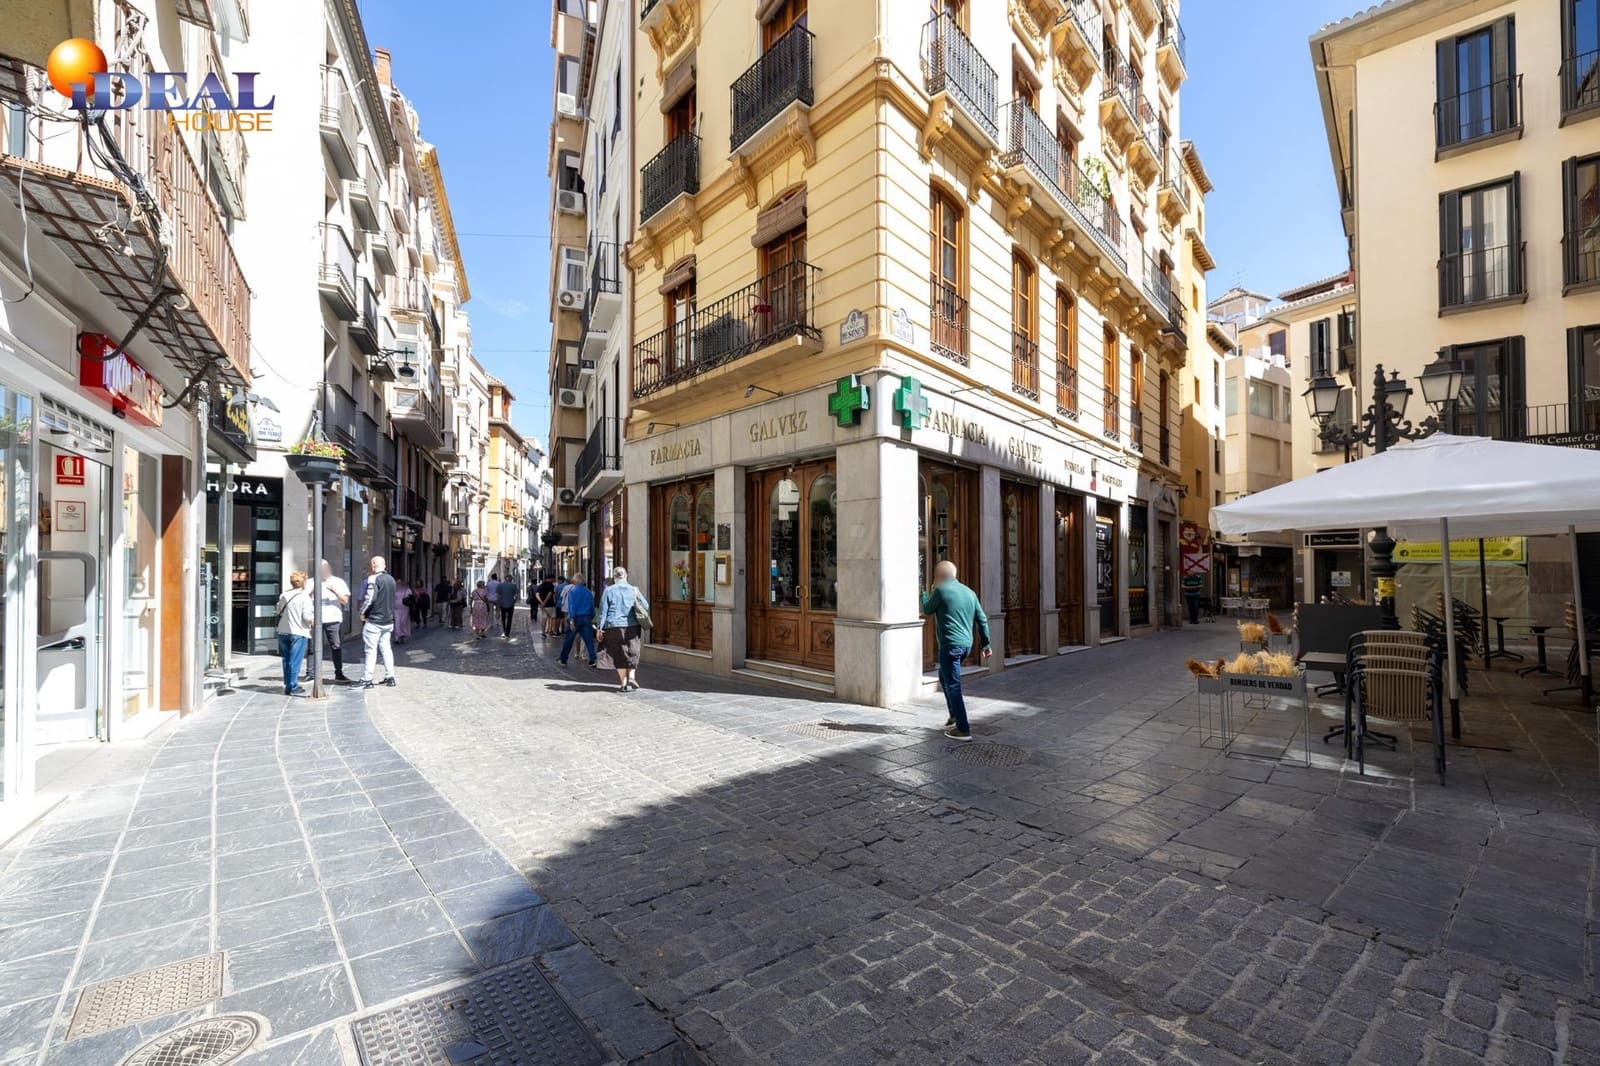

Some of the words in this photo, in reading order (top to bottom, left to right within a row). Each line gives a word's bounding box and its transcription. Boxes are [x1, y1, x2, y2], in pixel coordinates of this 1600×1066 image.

[650, 438, 702, 466] FARMACIA
[749, 410, 808, 442] GALVEZ
[924, 408, 986, 446] FARMACIA
[1008, 436, 1043, 464] GALVEZ
[1547, 435, 1581, 445] Center
[207, 479, 268, 495] HORA
